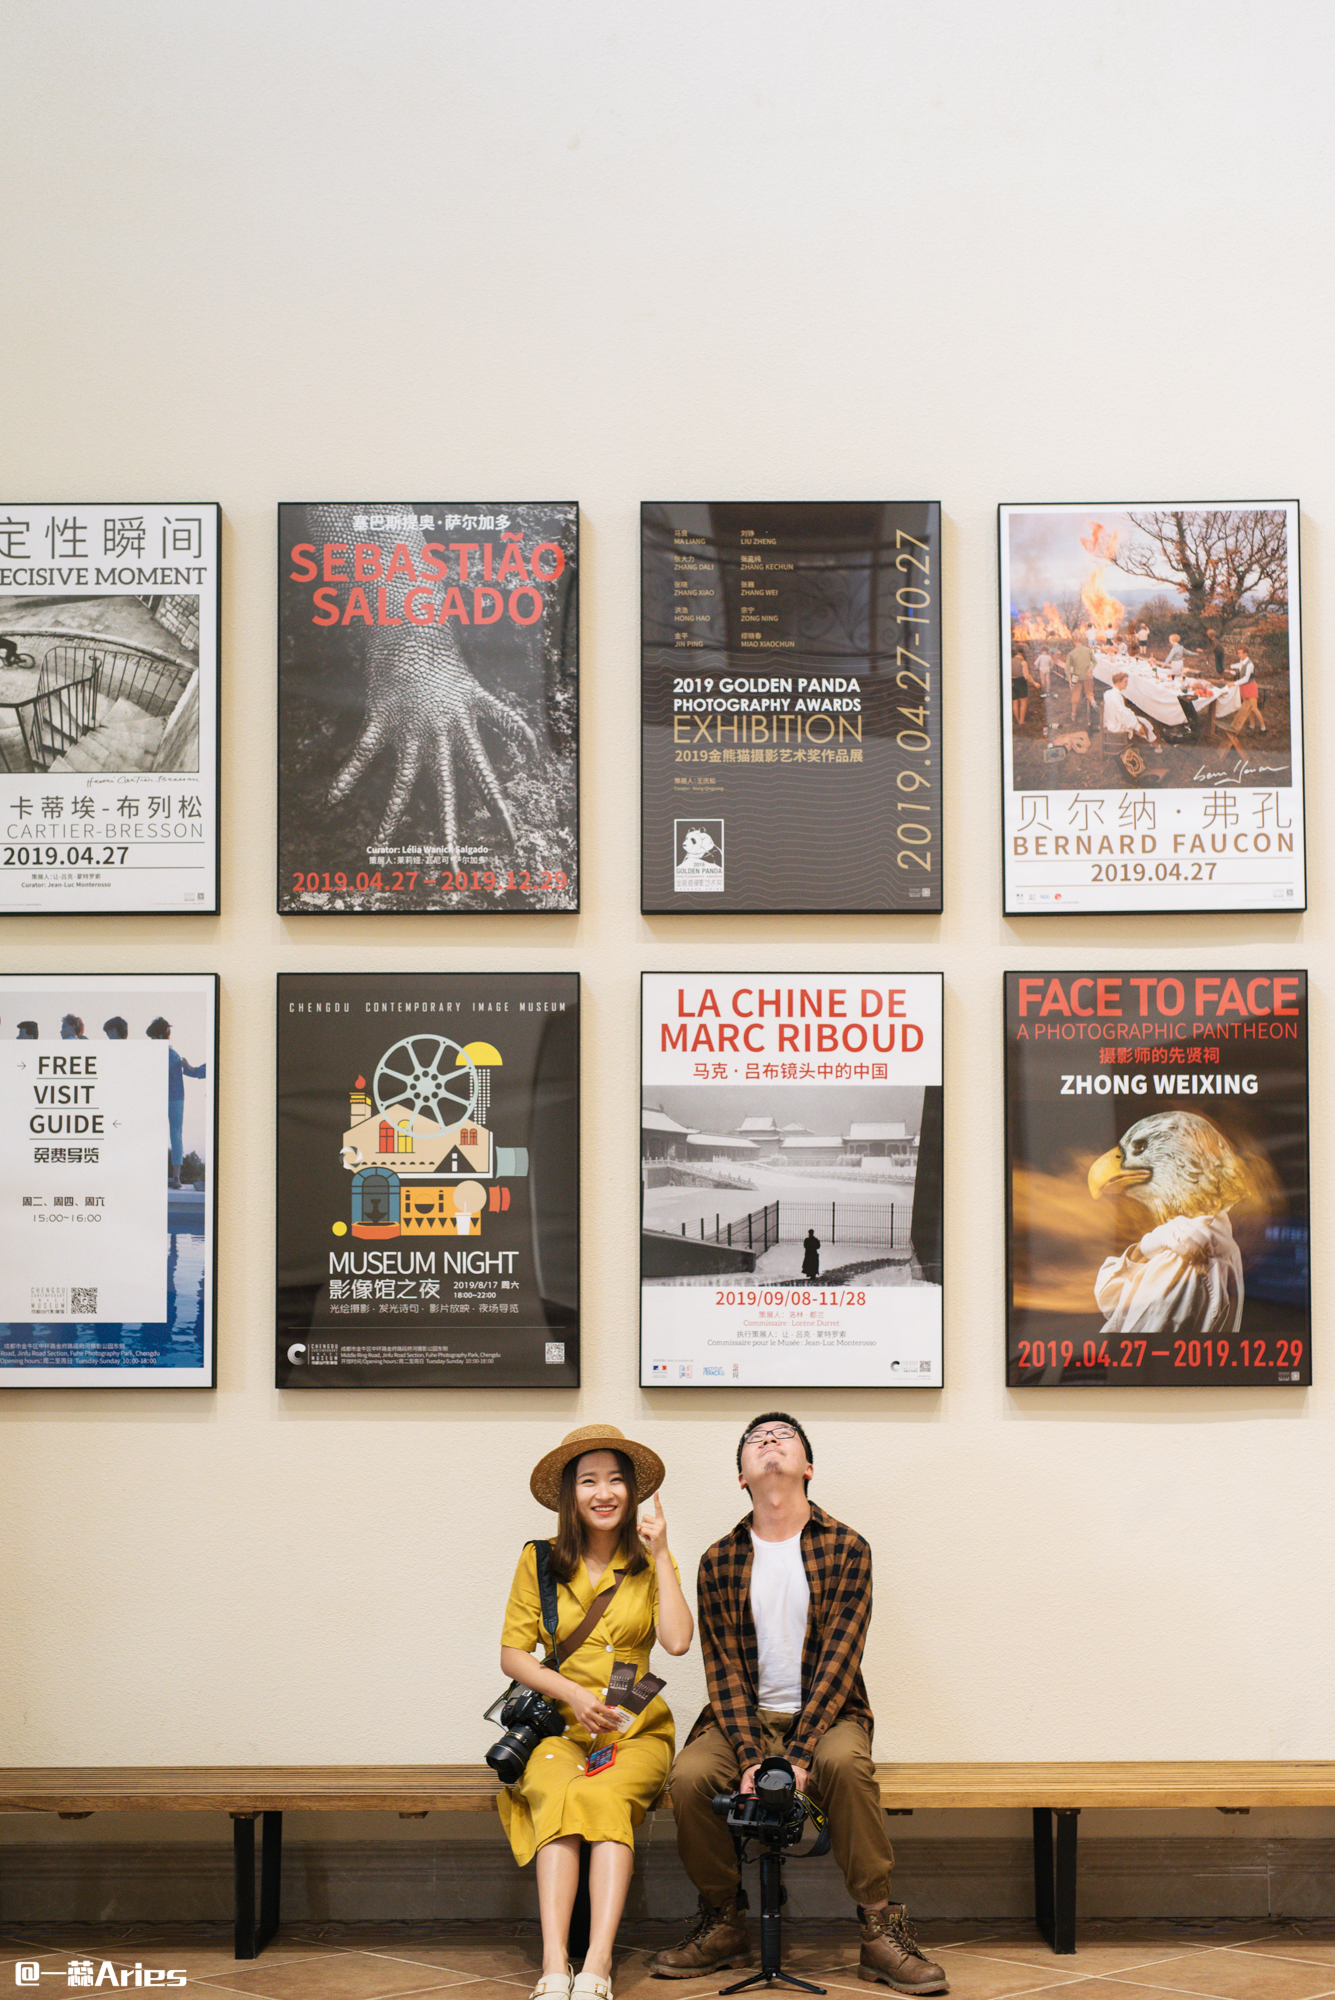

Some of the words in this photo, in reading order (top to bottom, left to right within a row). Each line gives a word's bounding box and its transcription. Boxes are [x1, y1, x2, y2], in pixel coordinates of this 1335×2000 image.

[289, 532, 565, 582] SEBASTIÃO
[0, 568, 89, 586] ECISIVE
[94, 567, 207, 585] MOMENT
[312, 586, 543, 626] SALGADO
[673, 678, 714, 693] 2019
[719, 678, 792, 693] GOLDEN
[798, 678, 861, 693] PANDA
[673, 698, 790, 712] PHOTOGRAPHY
[795, 698, 862, 712] AWARDS
[896, 529, 931, 872] 2019.04.27-10.27
[673, 714, 862, 744] EXHIBITION
[674, 749, 864, 763] 2019金熊猫摄影艺术奖作品展
[10, 795, 202, 819] 卡蒂埃-布列松
[1017, 790, 1292, 832] 贝尔纳·弗孔
[7, 823, 203, 839] CARTIER-BRESSON
[366, 846, 400, 854] Curator:
[402, 845, 422, 854] Lélia
[455, 846, 489, 856] Salgado
[1013, 834, 1157, 856] BERNARD
[1173, 833, 1293, 853] FAUCON
[3, 846, 129, 865] 2019.04.27
[292, 872, 419, 891] 2019.04.27
[441, 871, 567, 890] 2019.12.29
[1091, 862, 1217, 882] 2019.04.27
[677, 989, 721, 1018] LA
[731, 988, 847, 1018] CHINE
[860, 989, 907, 1018] DE
[1018, 978, 1123, 1017] FACE
[1130, 978, 1185, 1016] TO
[1195, 977, 1299, 1016] FACE
[289, 1002, 350, 1013] CHENGDU
[365, 1002, 461, 1012] CONTEMPORARY
[472, 1002, 509, 1012] IMAGE
[519, 1002, 566, 1012] MUSEUM
[661, 1023, 765, 1052] MARC
[778, 1023, 924, 1052] RIBOUD
[1017, 1024, 1029, 1040] A
[1035, 1023, 1187, 1040] PHOTOGRAPHIC
[1193, 1022, 1297, 1039] PANTHEON
[1099, 1047, 1220, 1064] 摄影师的先贤祠
[38, 1056, 97, 1075] FREE
[693, 1062, 888, 1080] 马克·吕布镜头中的中国
[1060, 1074, 1148, 1095] ZHONG
[1153, 1074, 1258, 1095] WEIXING
[33, 1085, 95, 1104] VISIT
[29, 1115, 104, 1133] GUIDE
[34, 1147, 99, 1163] 免费导览
[329, 1251, 436, 1274] MUSEUM
[444, 1251, 519, 1274] NIGHT
[329, 1279, 440, 1300] 影像馆之夜
[453, 1281, 498, 1289] 2019/8/17
[502, 1280, 520, 1289] 周六
[715, 1290, 866, 1307] 2019/09/08-11/28
[84, 1350, 120, 1358] Photography
[135, 1350, 160, 1358] Chengdu
